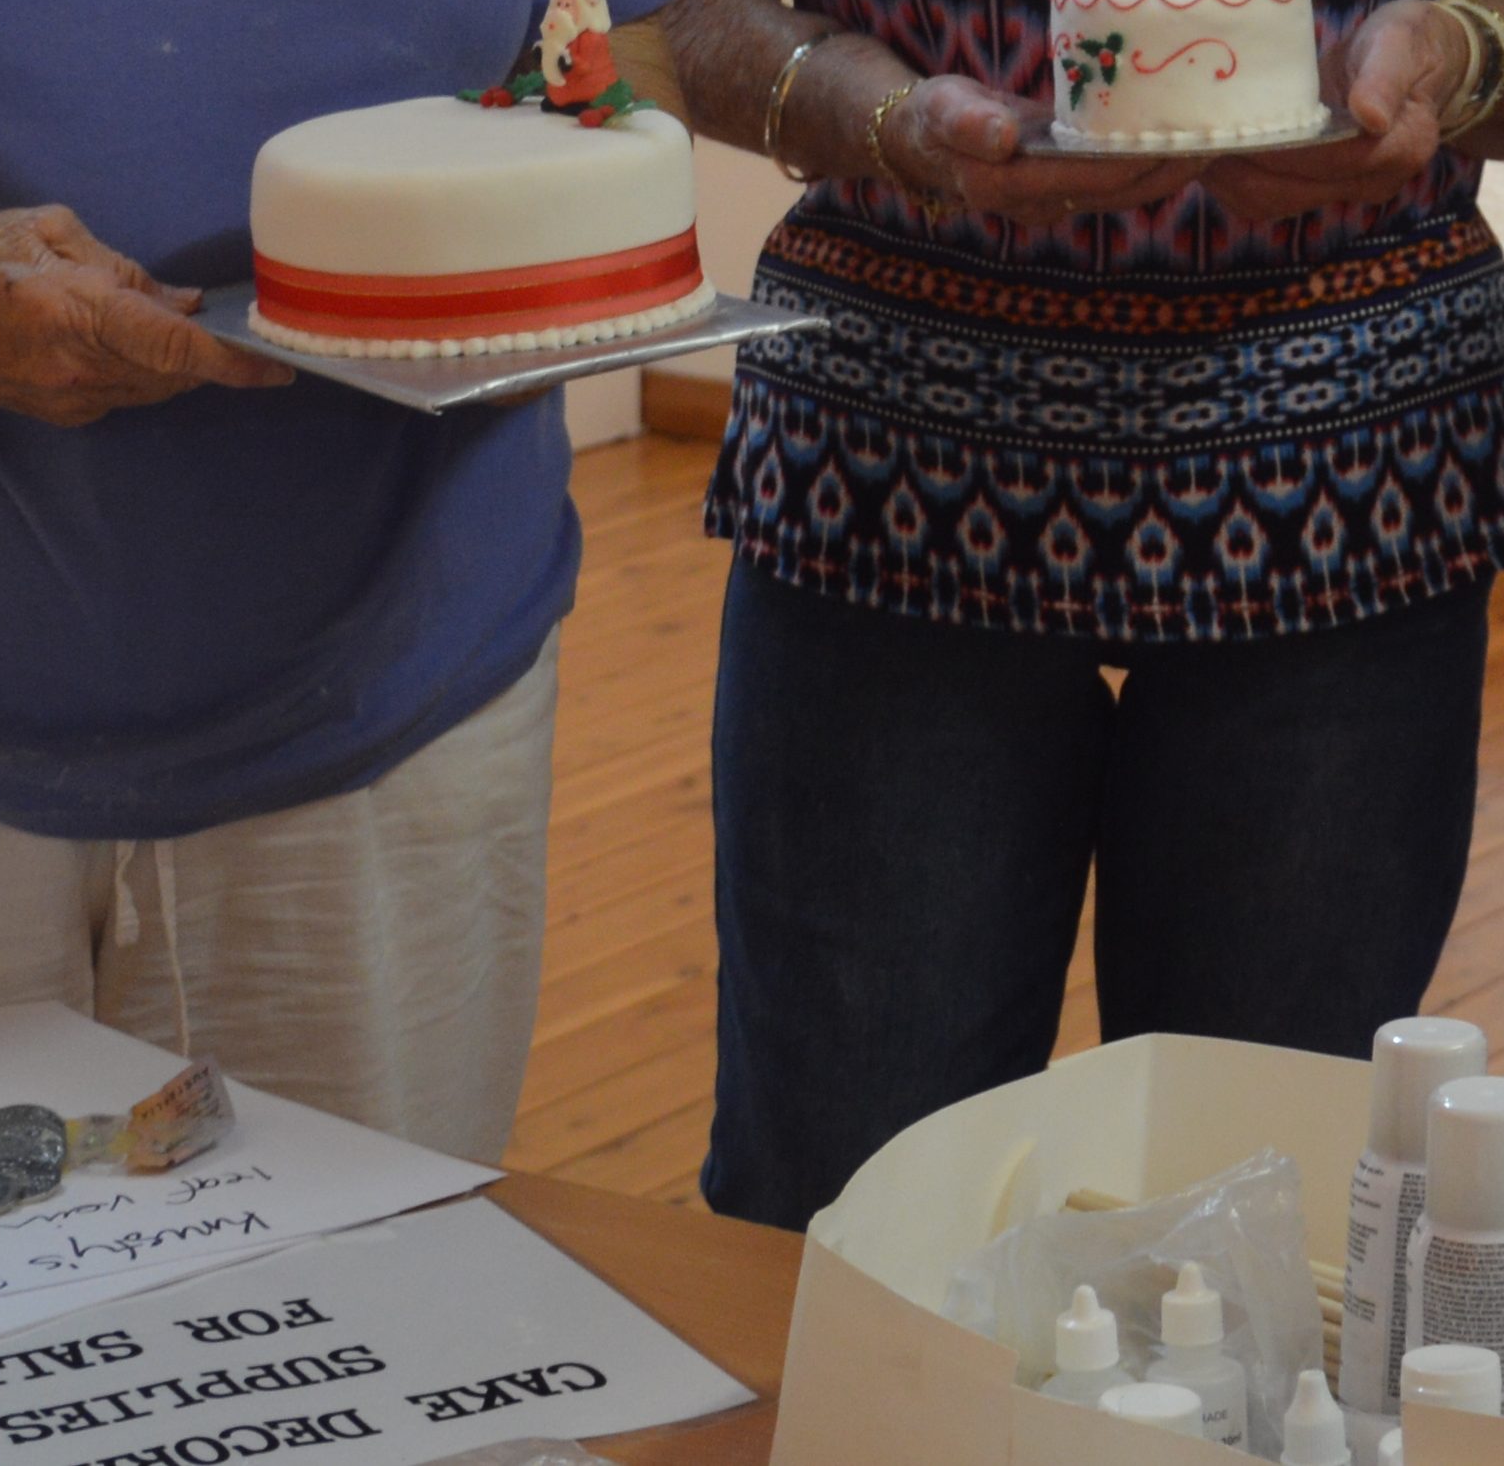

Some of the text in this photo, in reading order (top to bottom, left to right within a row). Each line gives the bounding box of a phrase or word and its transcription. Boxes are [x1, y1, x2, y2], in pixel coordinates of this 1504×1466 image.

[173, 1297, 334, 1344] FOR
[69, 1361, 609, 1466] CAKE DECOR
